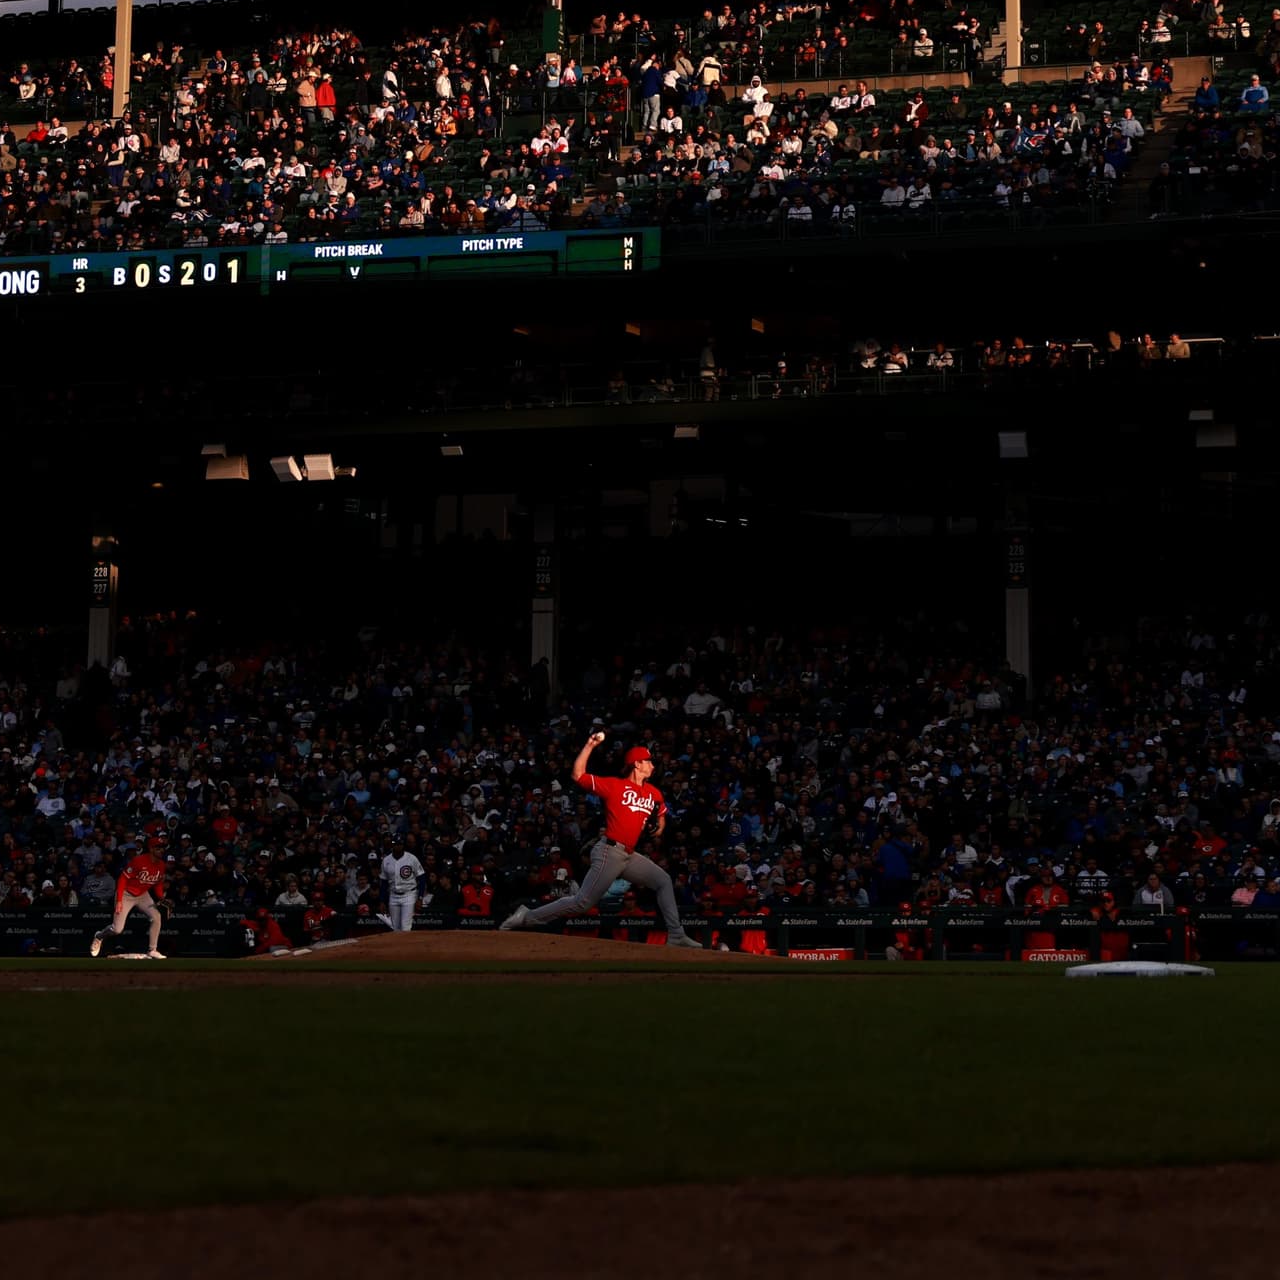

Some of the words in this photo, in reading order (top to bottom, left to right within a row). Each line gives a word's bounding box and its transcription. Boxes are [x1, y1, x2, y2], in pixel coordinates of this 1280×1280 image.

[314, 246, 345, 258] PITCH
[347, 243, 383, 256] BREAK
[462, 239, 495, 251] PITCH
[497, 237, 523, 250] TYPE
[72, 257, 88, 270] HR
[113, 267, 126, 285] B
[134, 263, 150, 288] 0
[158, 265, 171, 283] S
[180, 261, 195, 286] 2
[227, 259, 239, 283] 1
[276, 270, 286, 281] H
[350, 266, 360, 279] V
[75, 276, 85, 293] 3
[621, 789, 656, 810] Reds
[136, 871, 161, 881] Red
[1028, 953, 1087, 962] GATORADE
